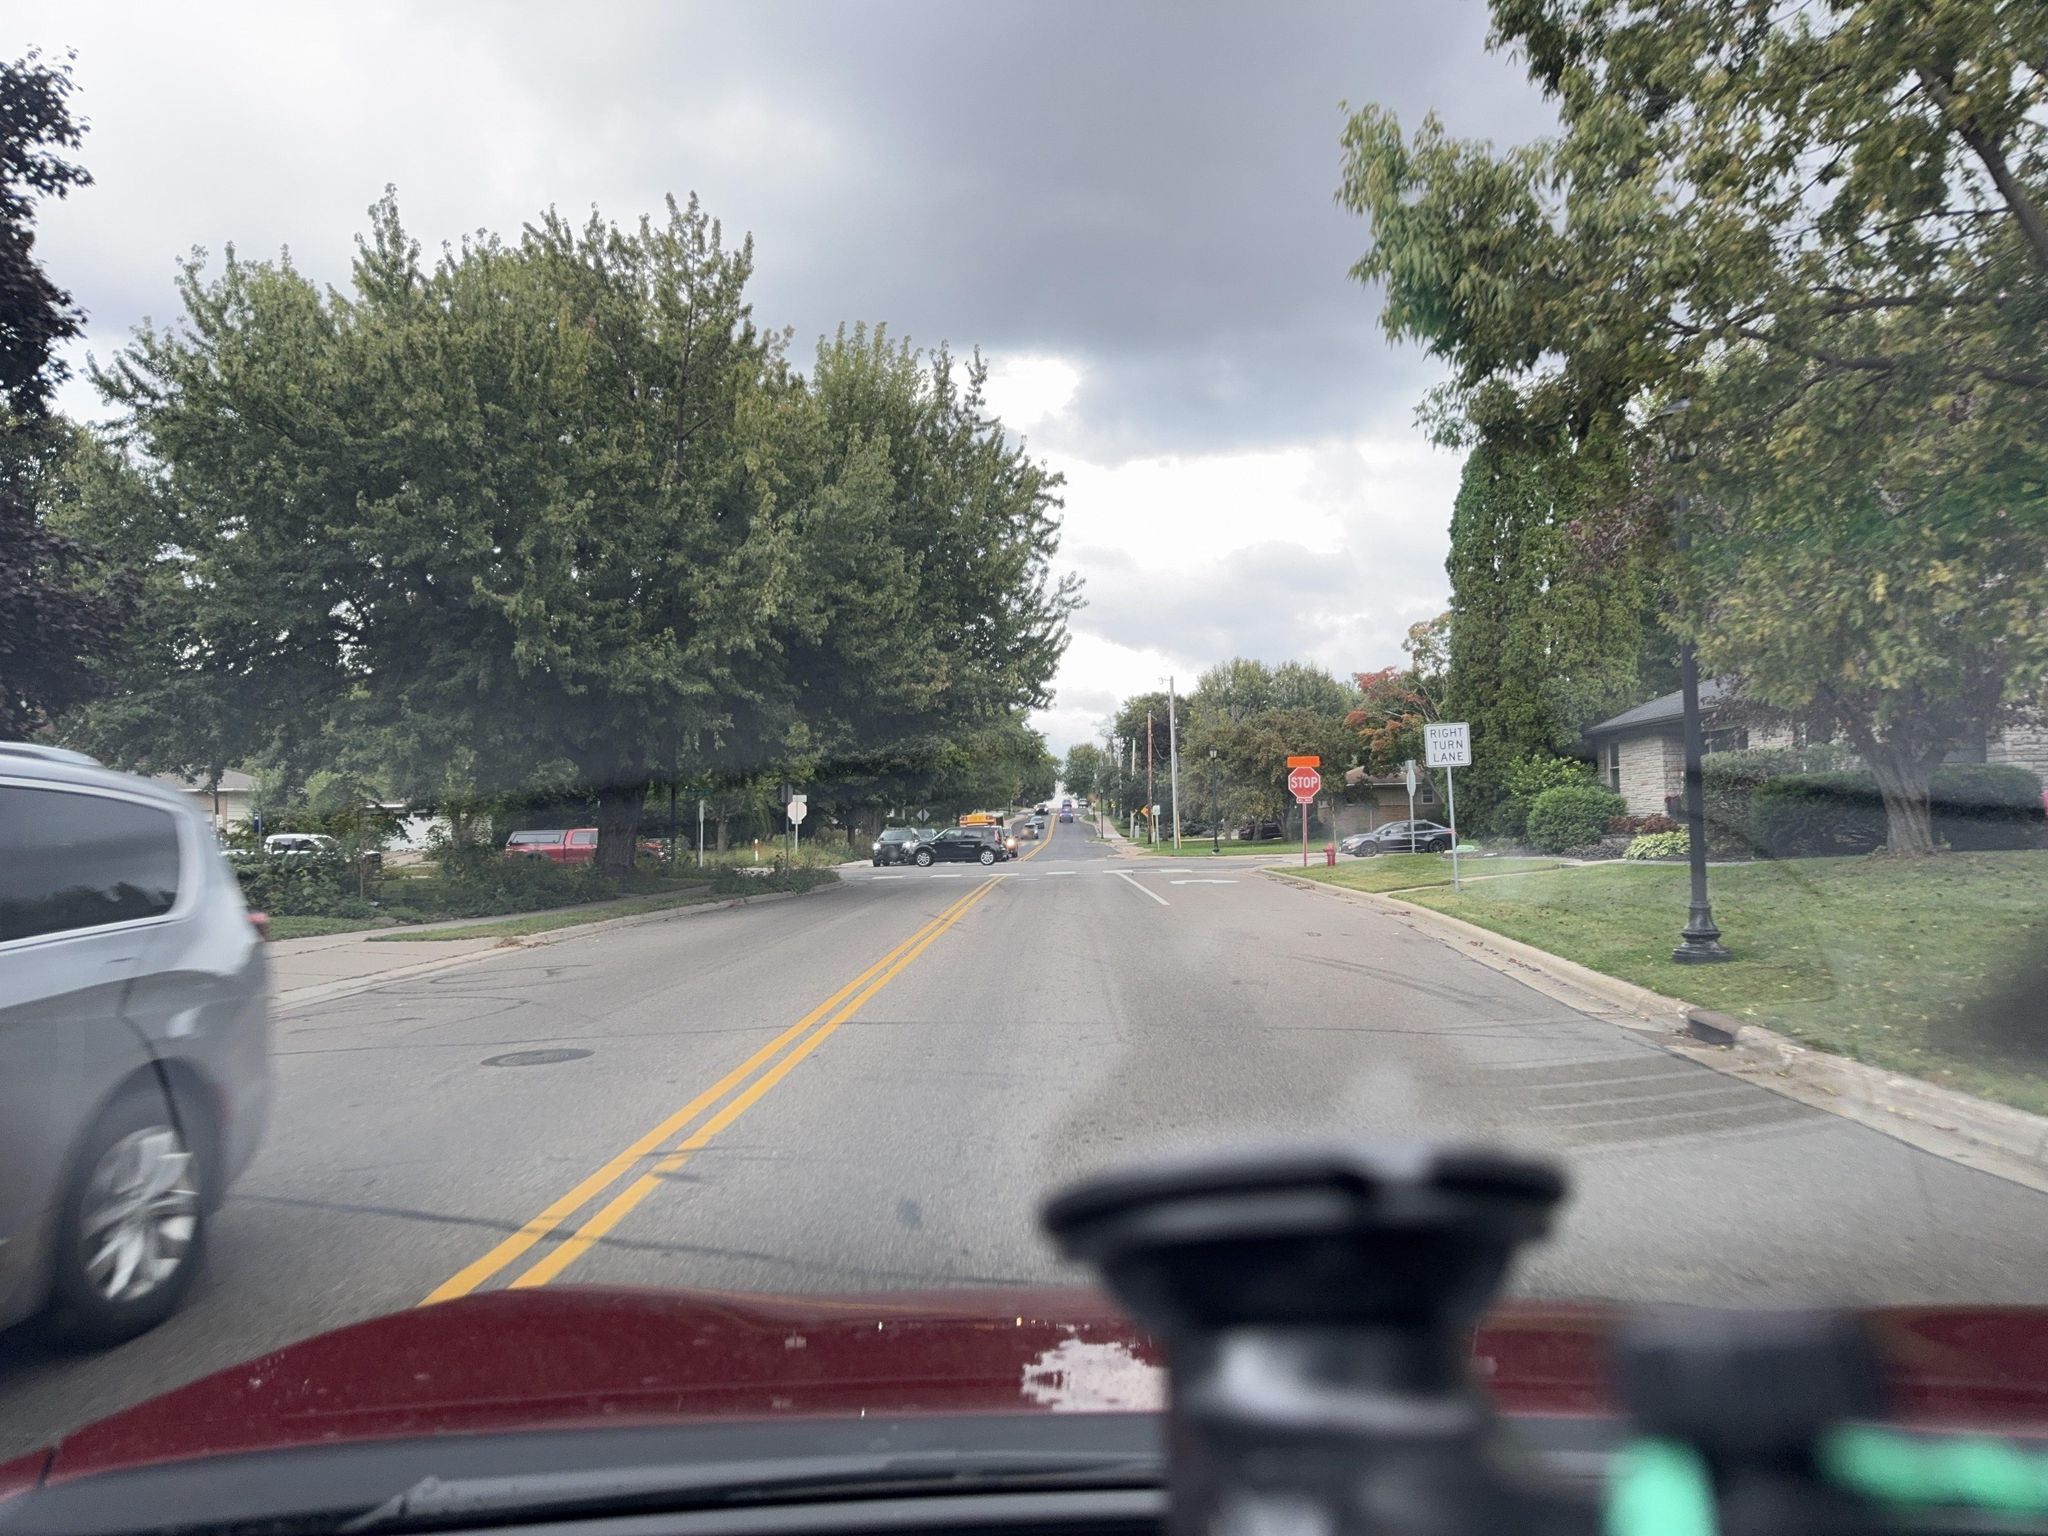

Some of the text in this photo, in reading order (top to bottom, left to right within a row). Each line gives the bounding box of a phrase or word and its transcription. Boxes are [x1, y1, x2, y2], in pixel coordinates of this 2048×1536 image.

[1430, 727, 1463, 738] RIGHT
[1432, 740, 1463, 750] TURN
[1433, 751, 1464, 762] LANE
[1291, 776, 1318, 789] STOP
